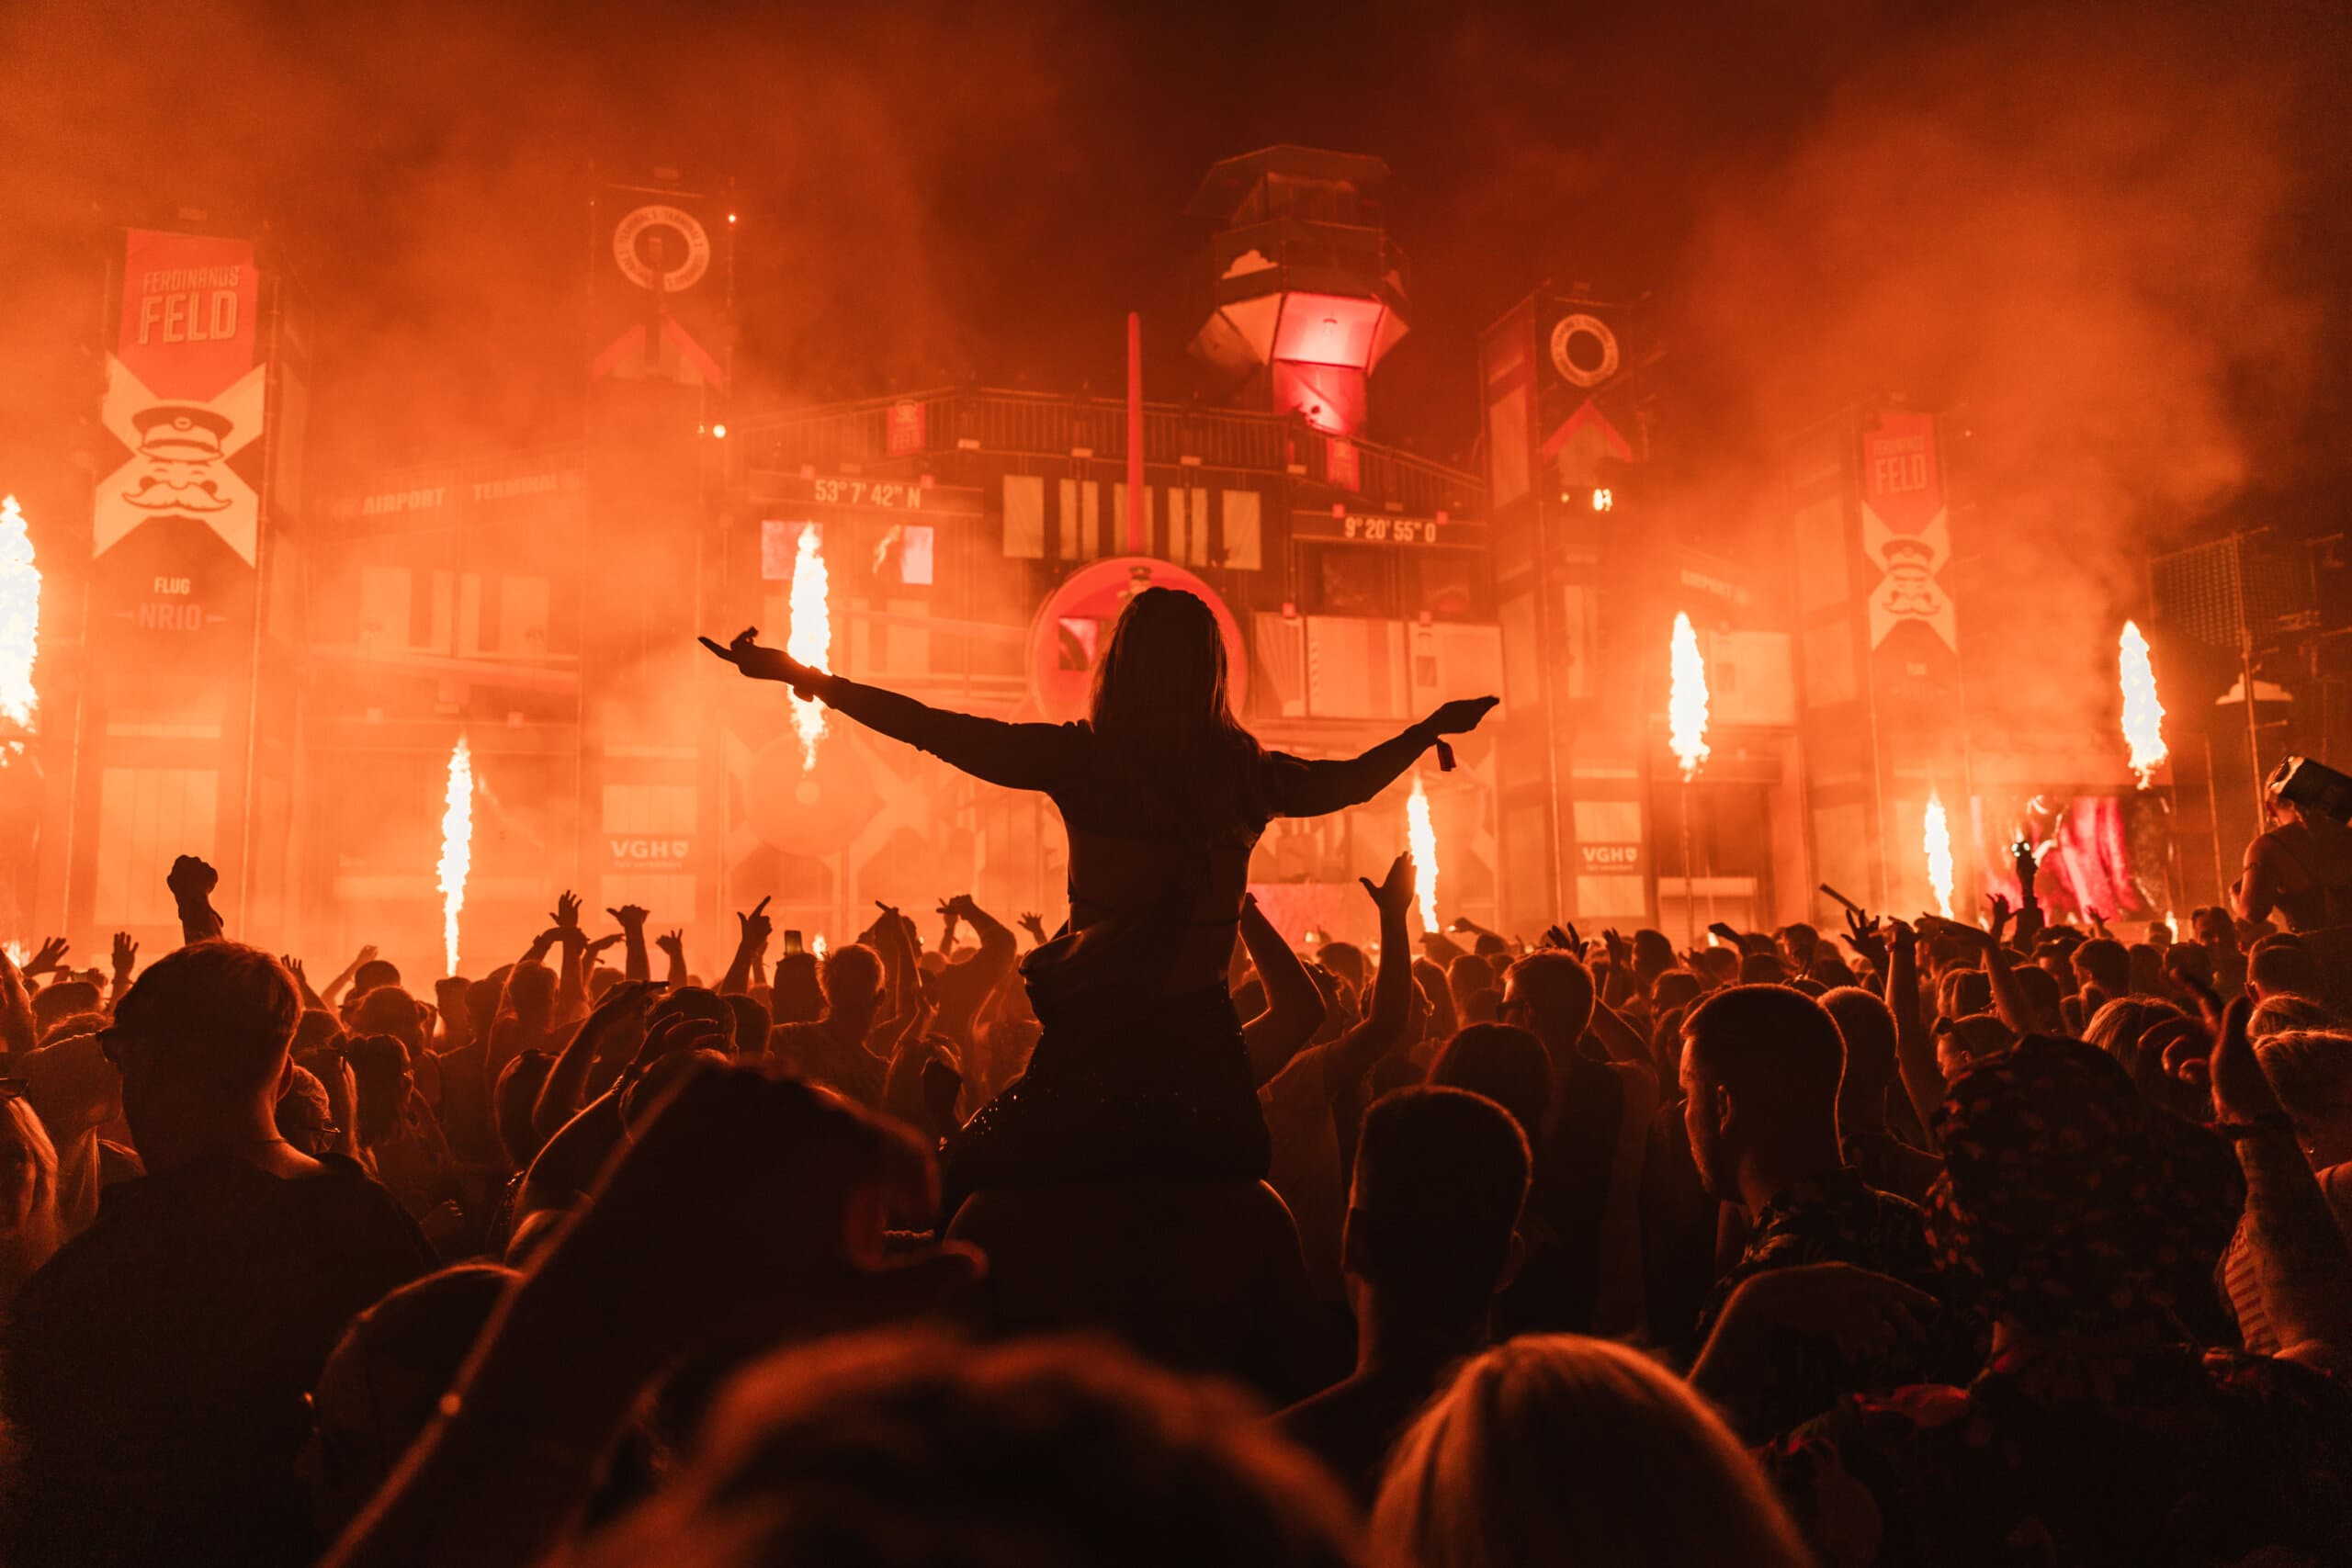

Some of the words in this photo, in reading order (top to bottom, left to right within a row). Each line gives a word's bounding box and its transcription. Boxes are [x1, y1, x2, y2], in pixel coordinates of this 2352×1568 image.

[143, 265, 239, 295] FERDINANDS
[138, 290, 237, 344] FELD
[1875, 454, 1926, 495] FELD
[362, 487, 446, 514] AIRPORT
[472, 473, 558, 499] TERMINAL
[908, 486, 921, 508] N
[153, 575, 191, 595] FLUG
[610, 840, 668, 858] VGH
[1583, 847, 1623, 862] VGH
